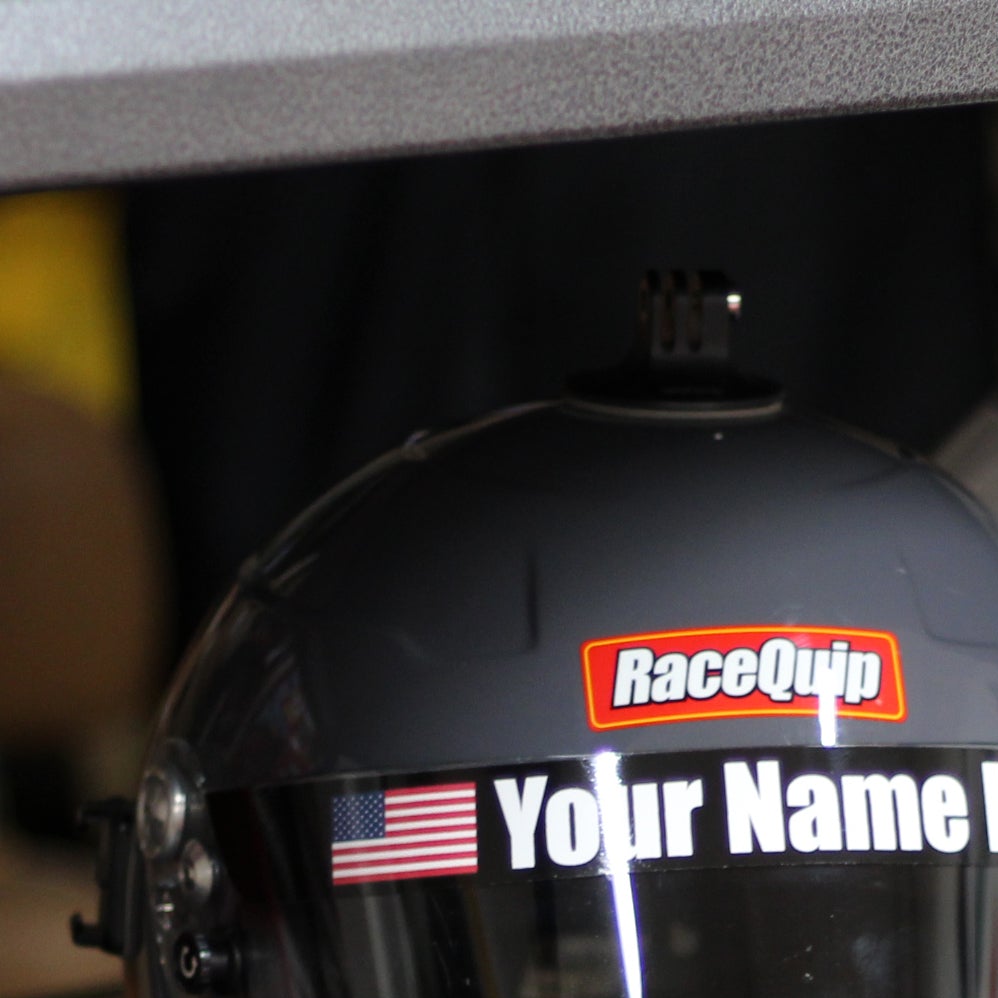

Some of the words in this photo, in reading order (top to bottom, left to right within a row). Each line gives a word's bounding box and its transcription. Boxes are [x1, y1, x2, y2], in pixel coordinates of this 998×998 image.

[611, 637, 883, 708] RaceQuip
[493, 774, 704, 870] Your
[722, 760, 971, 854] Name
